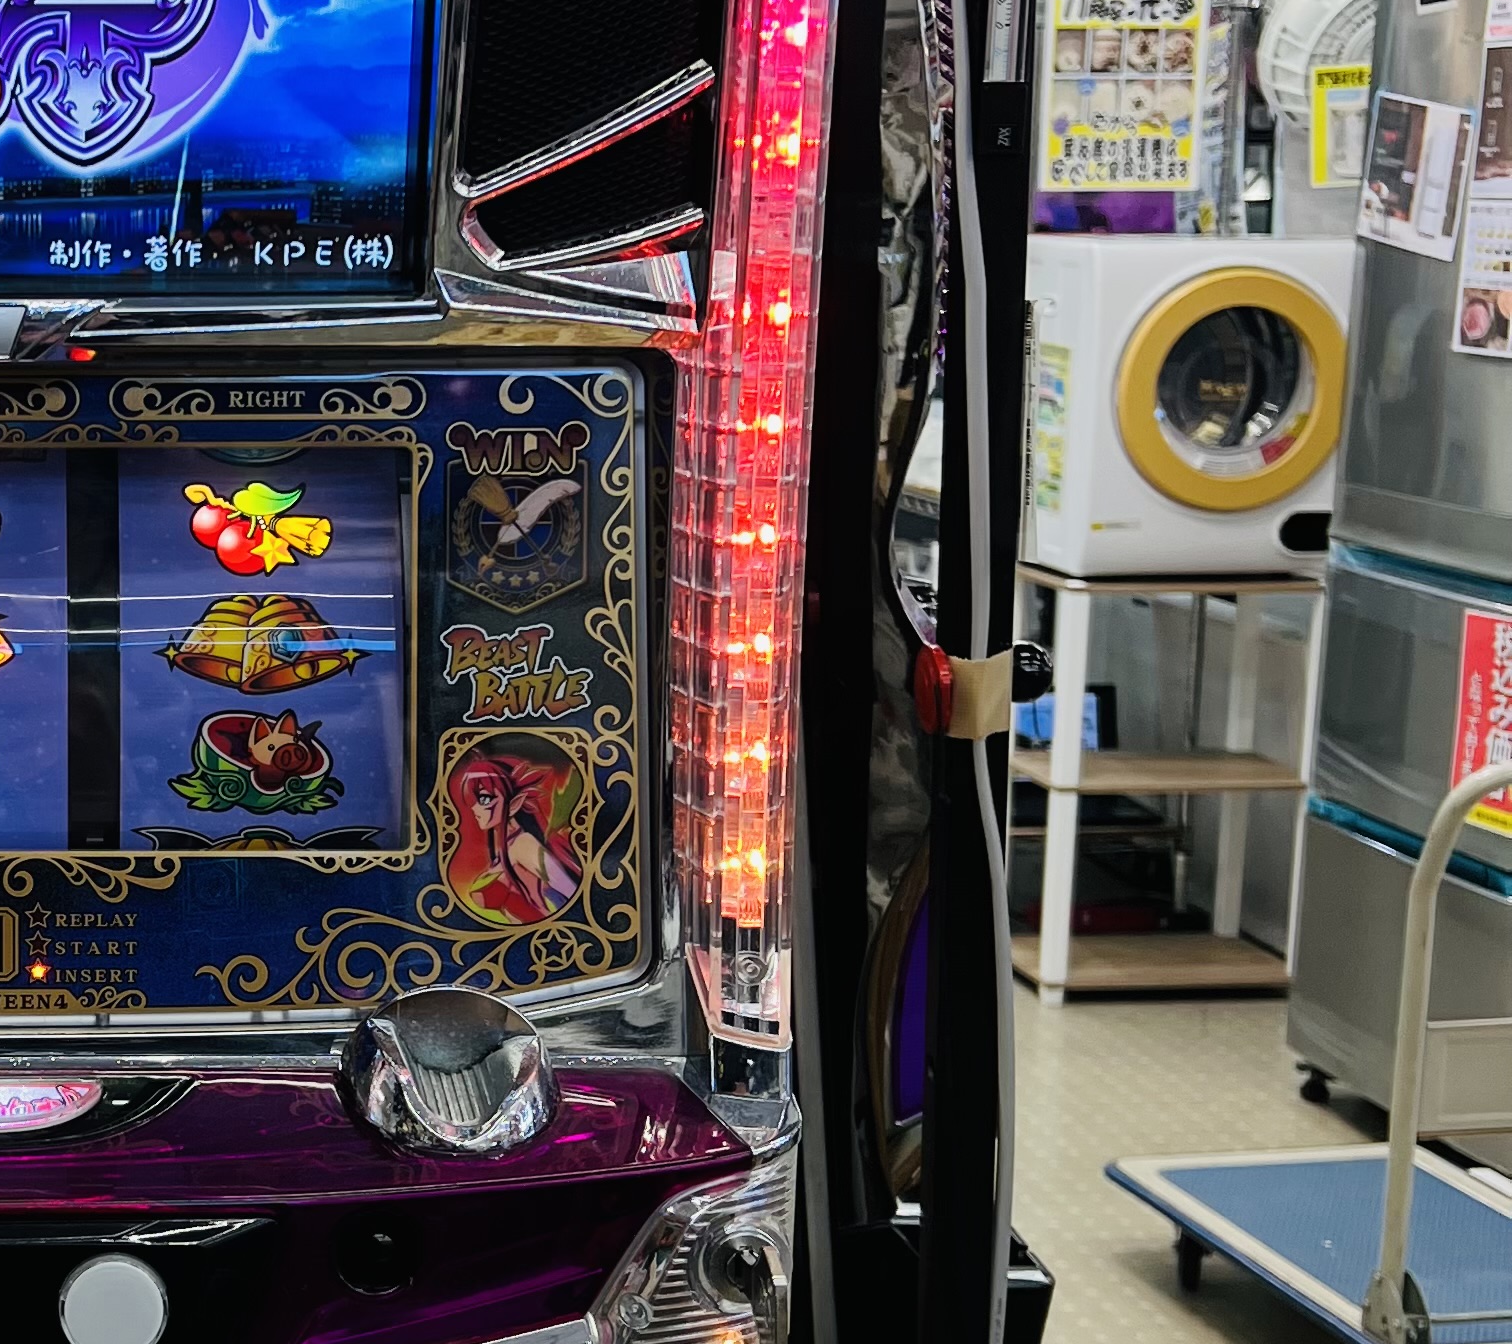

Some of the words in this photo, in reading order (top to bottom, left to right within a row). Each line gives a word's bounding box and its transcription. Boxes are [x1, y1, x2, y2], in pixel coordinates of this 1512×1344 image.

[49, 237, 203, 272] 制作・著作
[228, 390, 306, 409] RIGHT
[54, 913, 138, 928] REPLAY
[54, 941, 138, 955] START
[54, 969, 138, 983] INSERT
